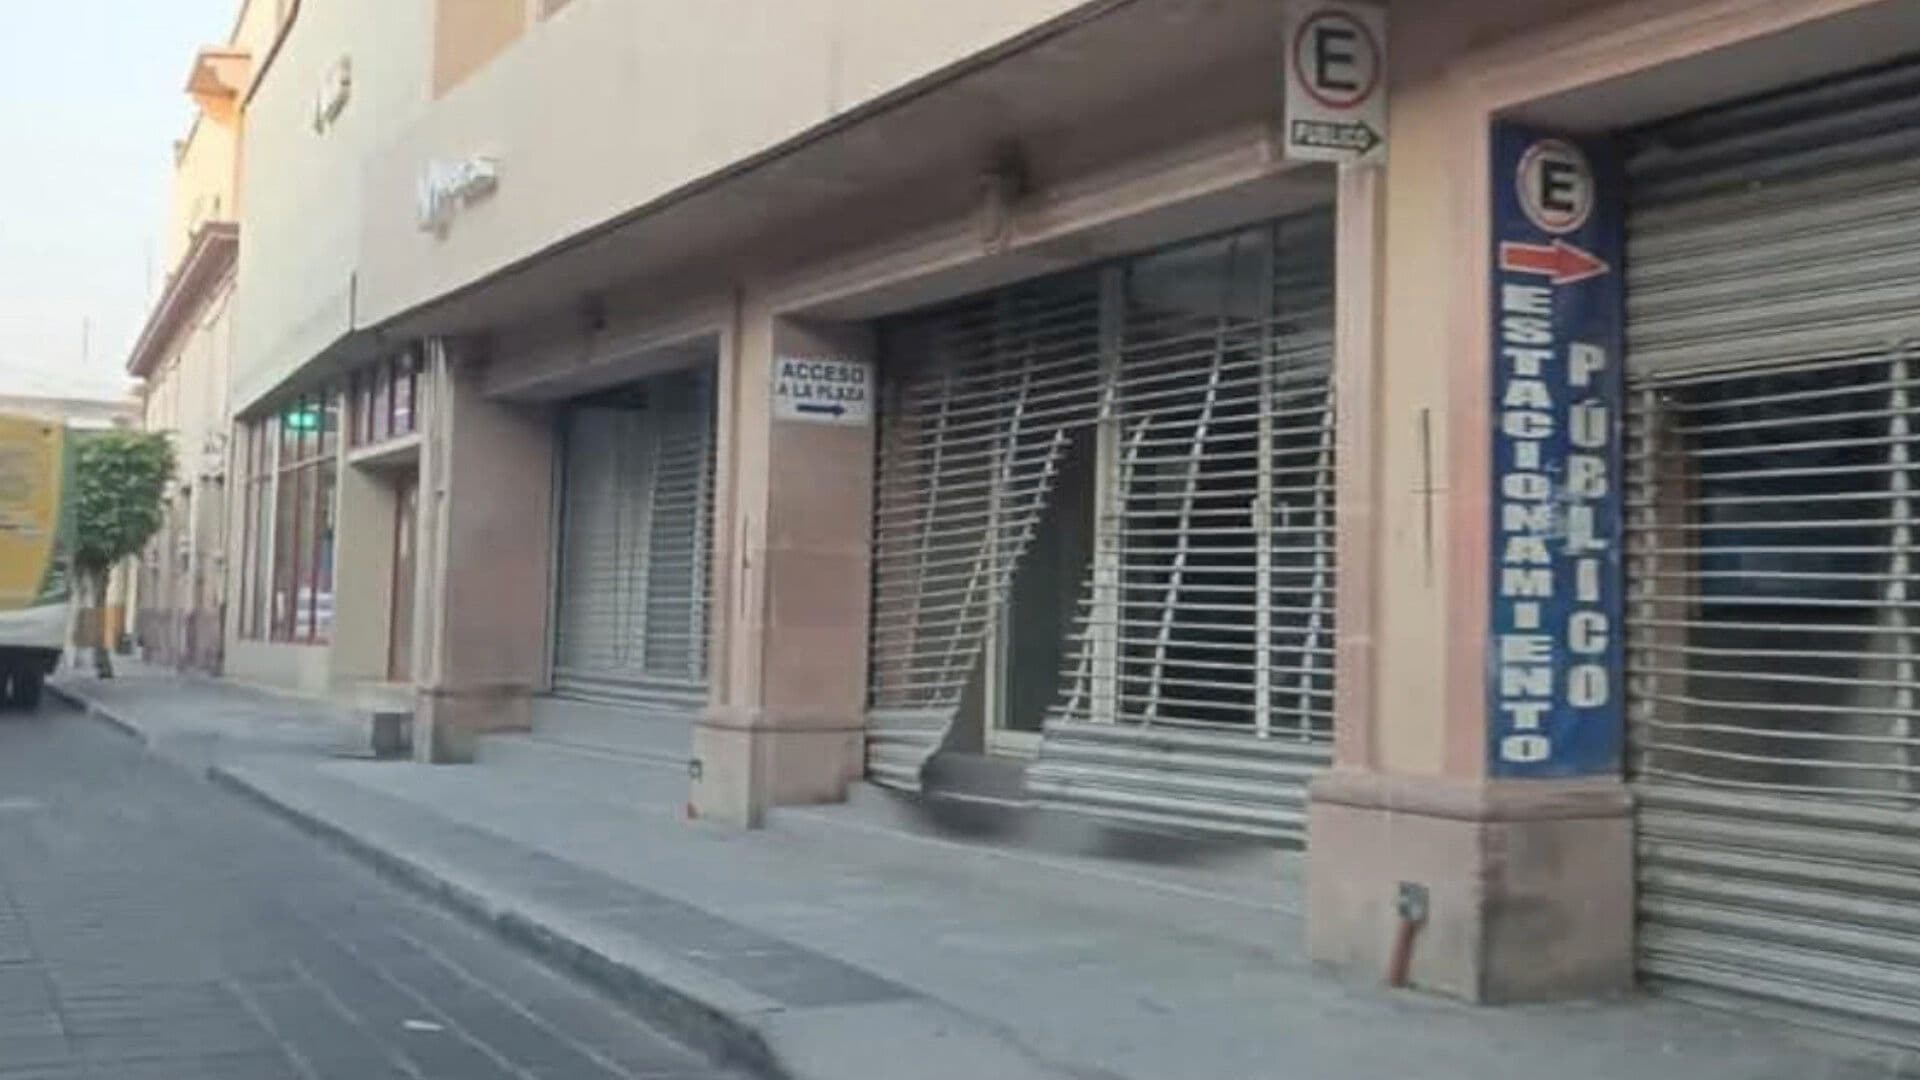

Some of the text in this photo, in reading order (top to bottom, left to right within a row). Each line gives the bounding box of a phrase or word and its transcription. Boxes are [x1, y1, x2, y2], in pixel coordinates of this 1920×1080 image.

[1315, 28, 1357, 91] E
[1541, 159, 1574, 212] E
[779, 382, 788, 395] A
[793, 383, 811, 398] LA
[782, 363, 864, 385] ACCESO
[1501, 284, 1555, 764] ESTACIONAMIENTO
[1567, 341, 1609, 708] PÚBLICO
